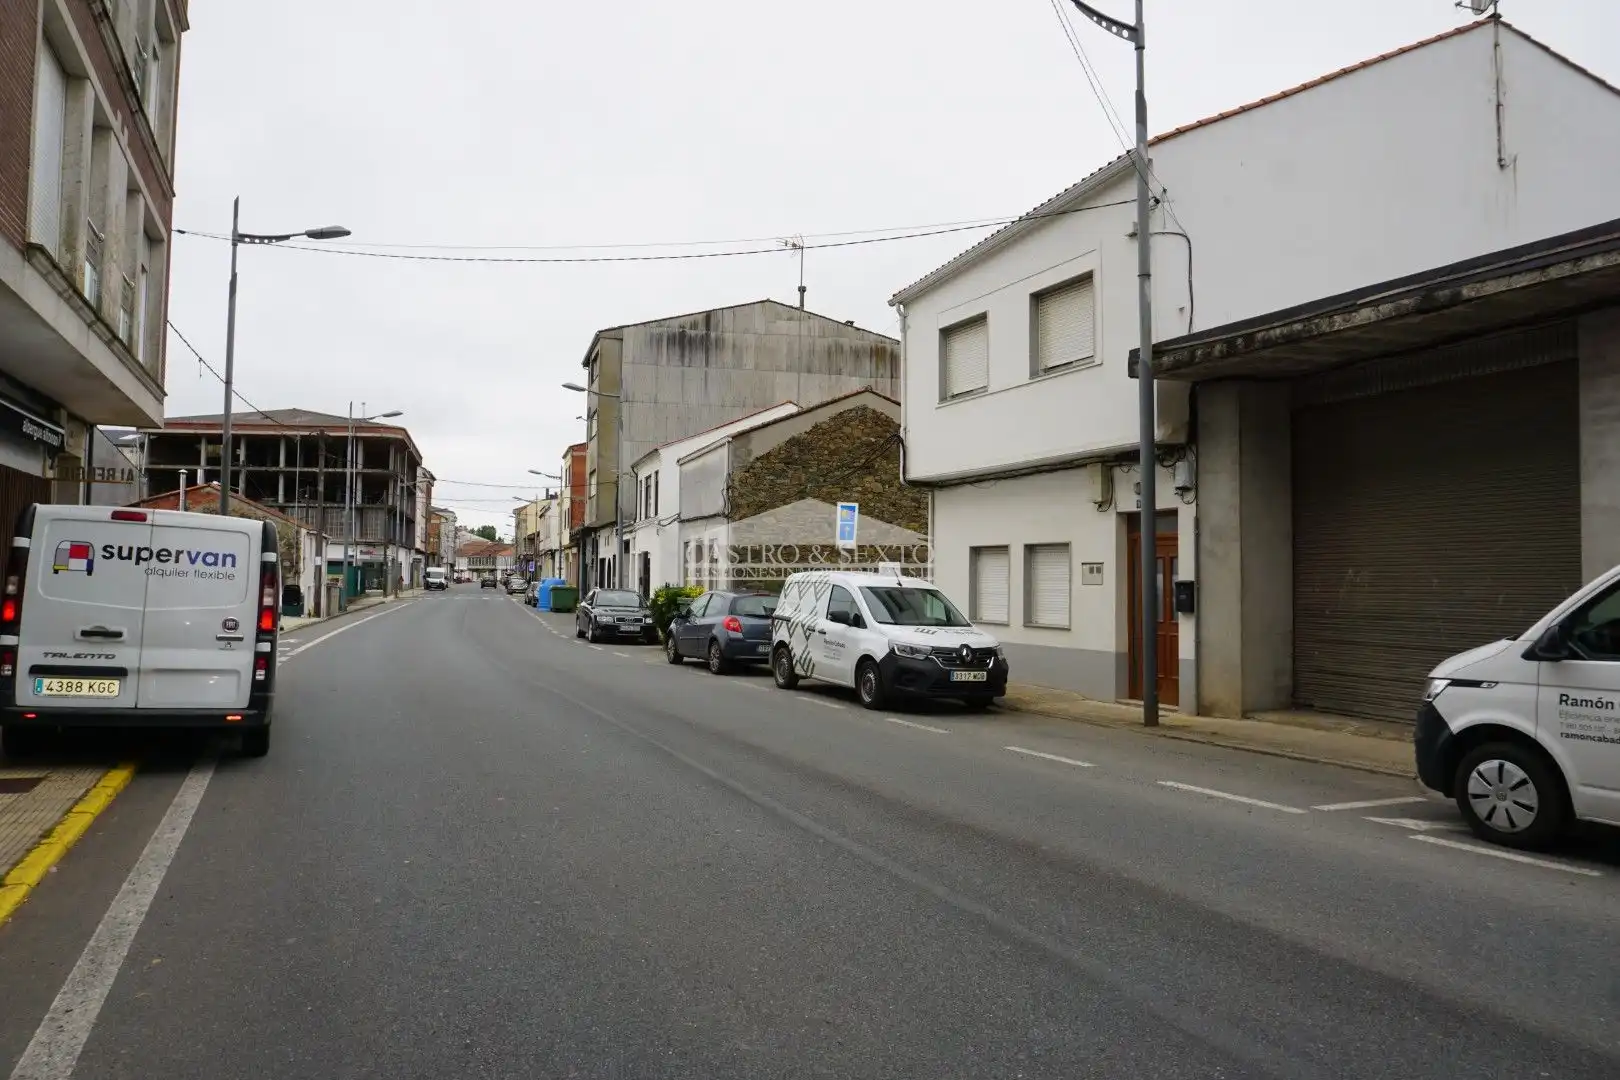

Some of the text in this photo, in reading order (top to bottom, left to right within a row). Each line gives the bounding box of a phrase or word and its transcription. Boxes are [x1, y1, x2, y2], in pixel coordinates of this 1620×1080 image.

[101, 543, 237, 568] supervan
[144, 567, 236, 581] alquiler flexible
[46, 680, 116, 694] 4388 KGC
[1559, 693, 1614, 710] Ramón
